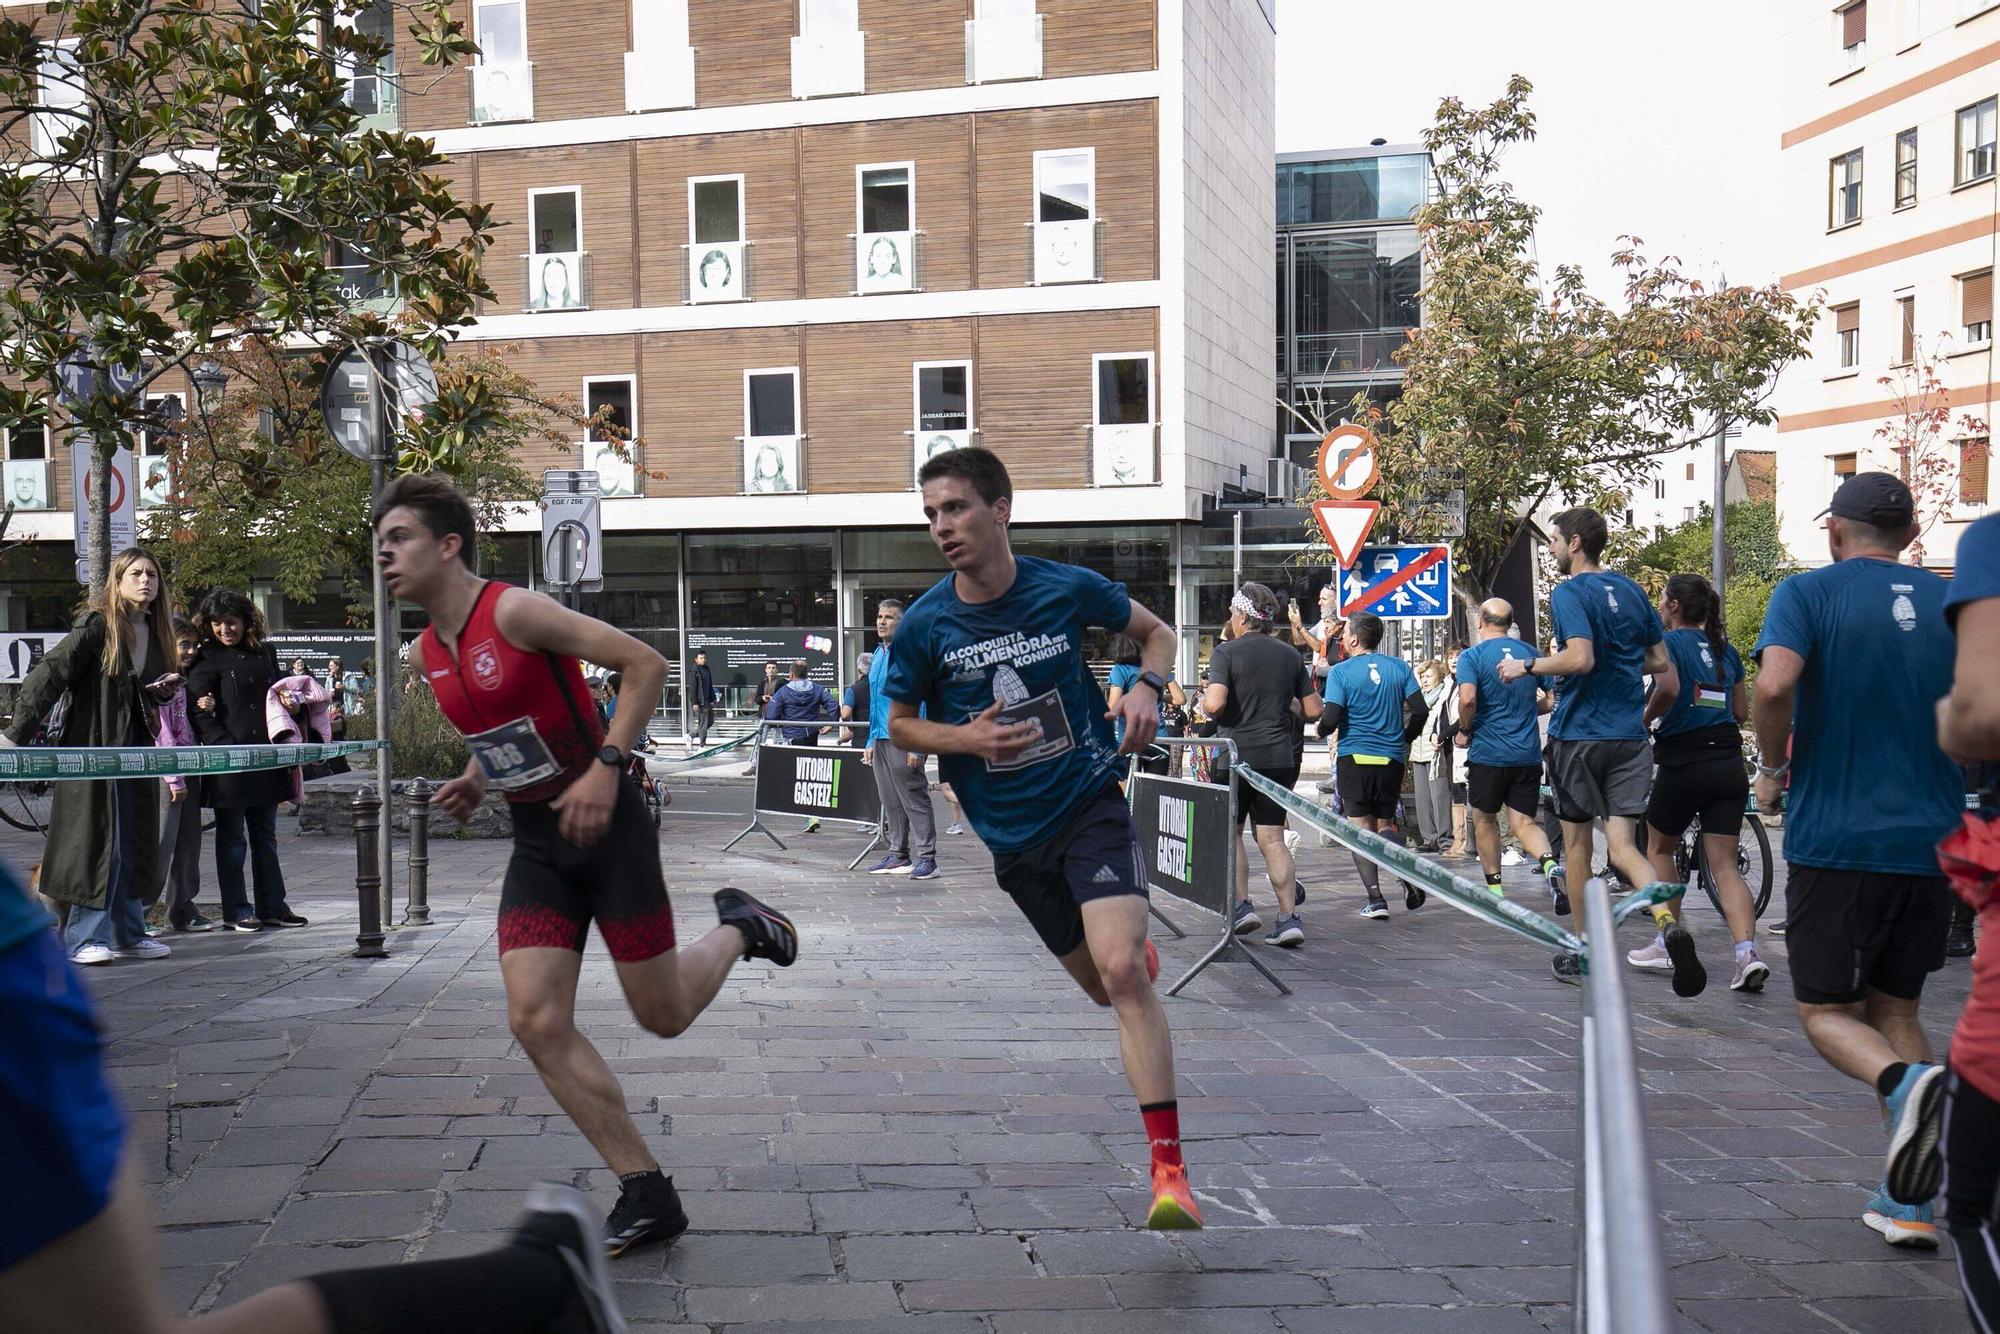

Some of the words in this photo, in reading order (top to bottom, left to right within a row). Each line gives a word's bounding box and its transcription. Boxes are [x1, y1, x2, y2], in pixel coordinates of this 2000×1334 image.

[957, 631, 1025, 658] CONQUISTA
[1013, 641, 1071, 668] KONKISTA
[796, 757, 833, 782] VITORIA
[794, 781, 832, 807] GASTEIZ
[1159, 795, 1187, 839] VITORIA
[1157, 835, 1187, 882] GASTEIZ
